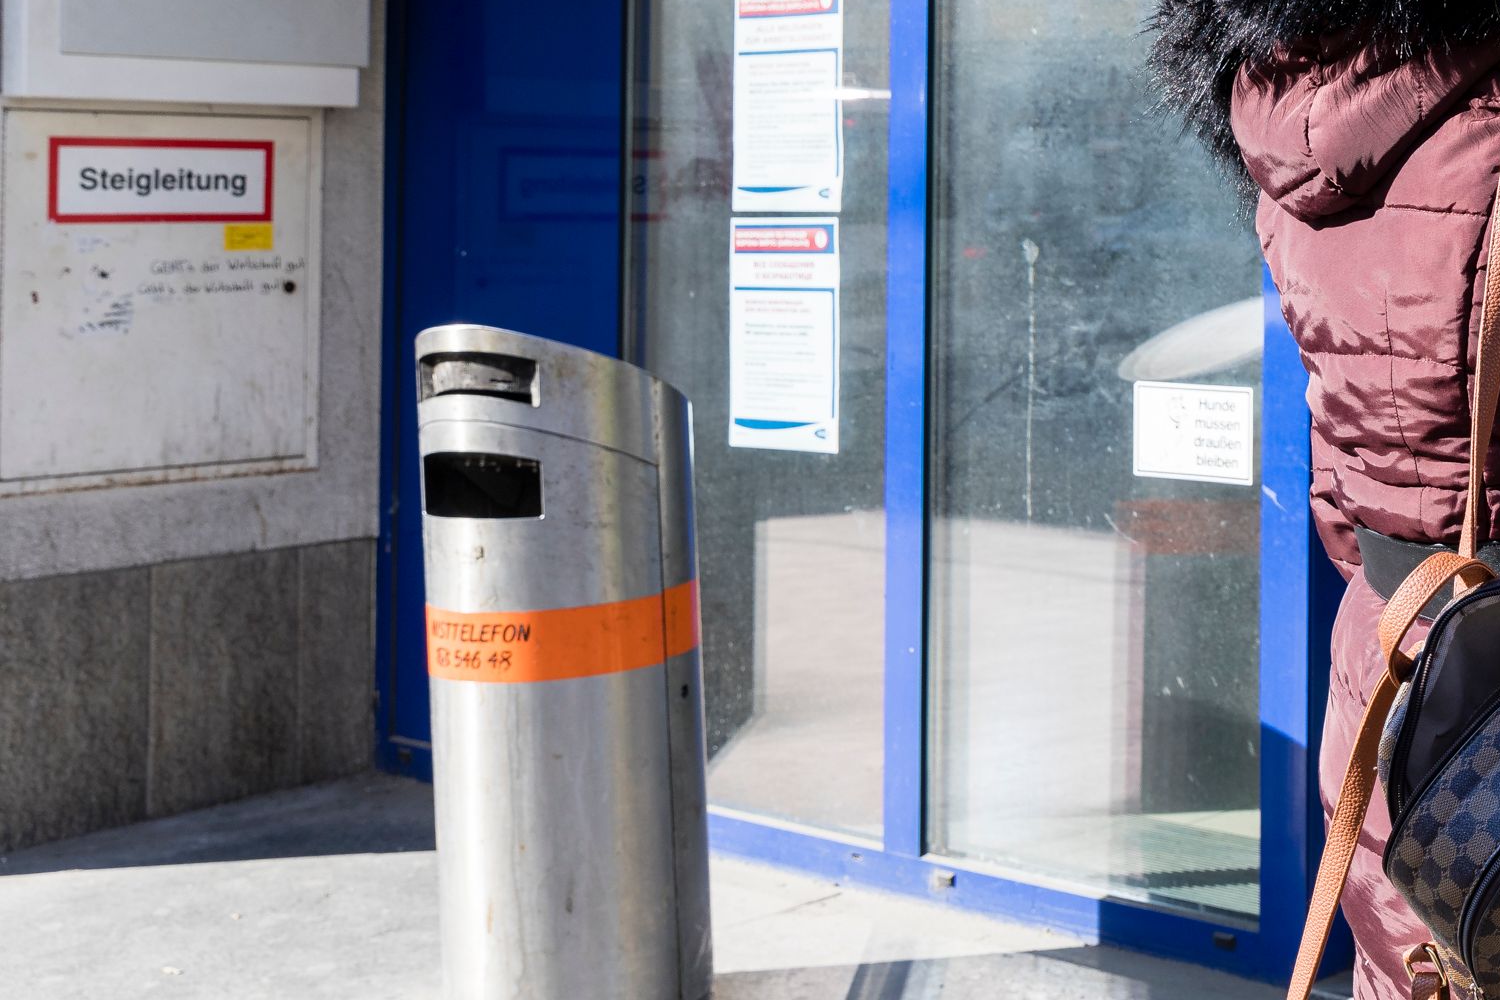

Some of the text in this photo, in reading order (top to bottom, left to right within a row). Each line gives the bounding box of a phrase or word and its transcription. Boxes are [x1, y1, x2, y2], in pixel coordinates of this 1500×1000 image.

[79, 166, 247, 197] Steigleitung
[1199, 400, 1236, 412] Hunde
[1196, 455, 1240, 469] bleiben
